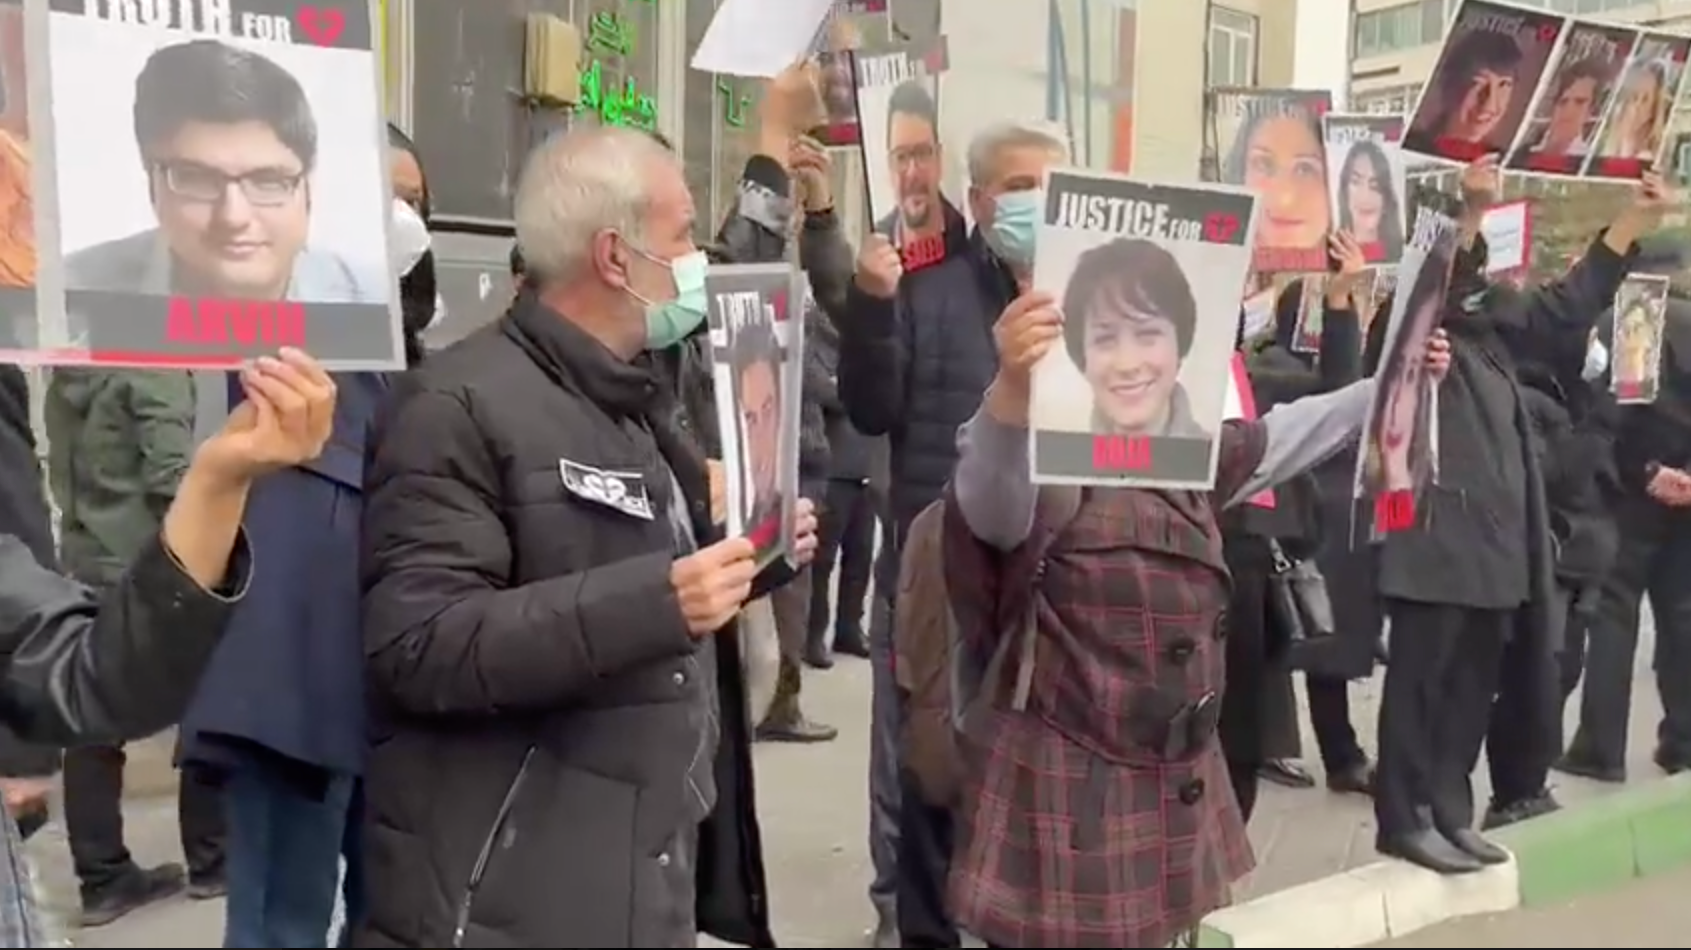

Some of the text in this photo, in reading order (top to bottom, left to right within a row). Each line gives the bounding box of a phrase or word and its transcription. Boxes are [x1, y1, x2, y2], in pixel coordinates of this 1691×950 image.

[240, 12, 293, 44] FOR
[1056, 191, 1203, 242] JUSTICE FOR
[166, 295, 307, 347] ARVIN
